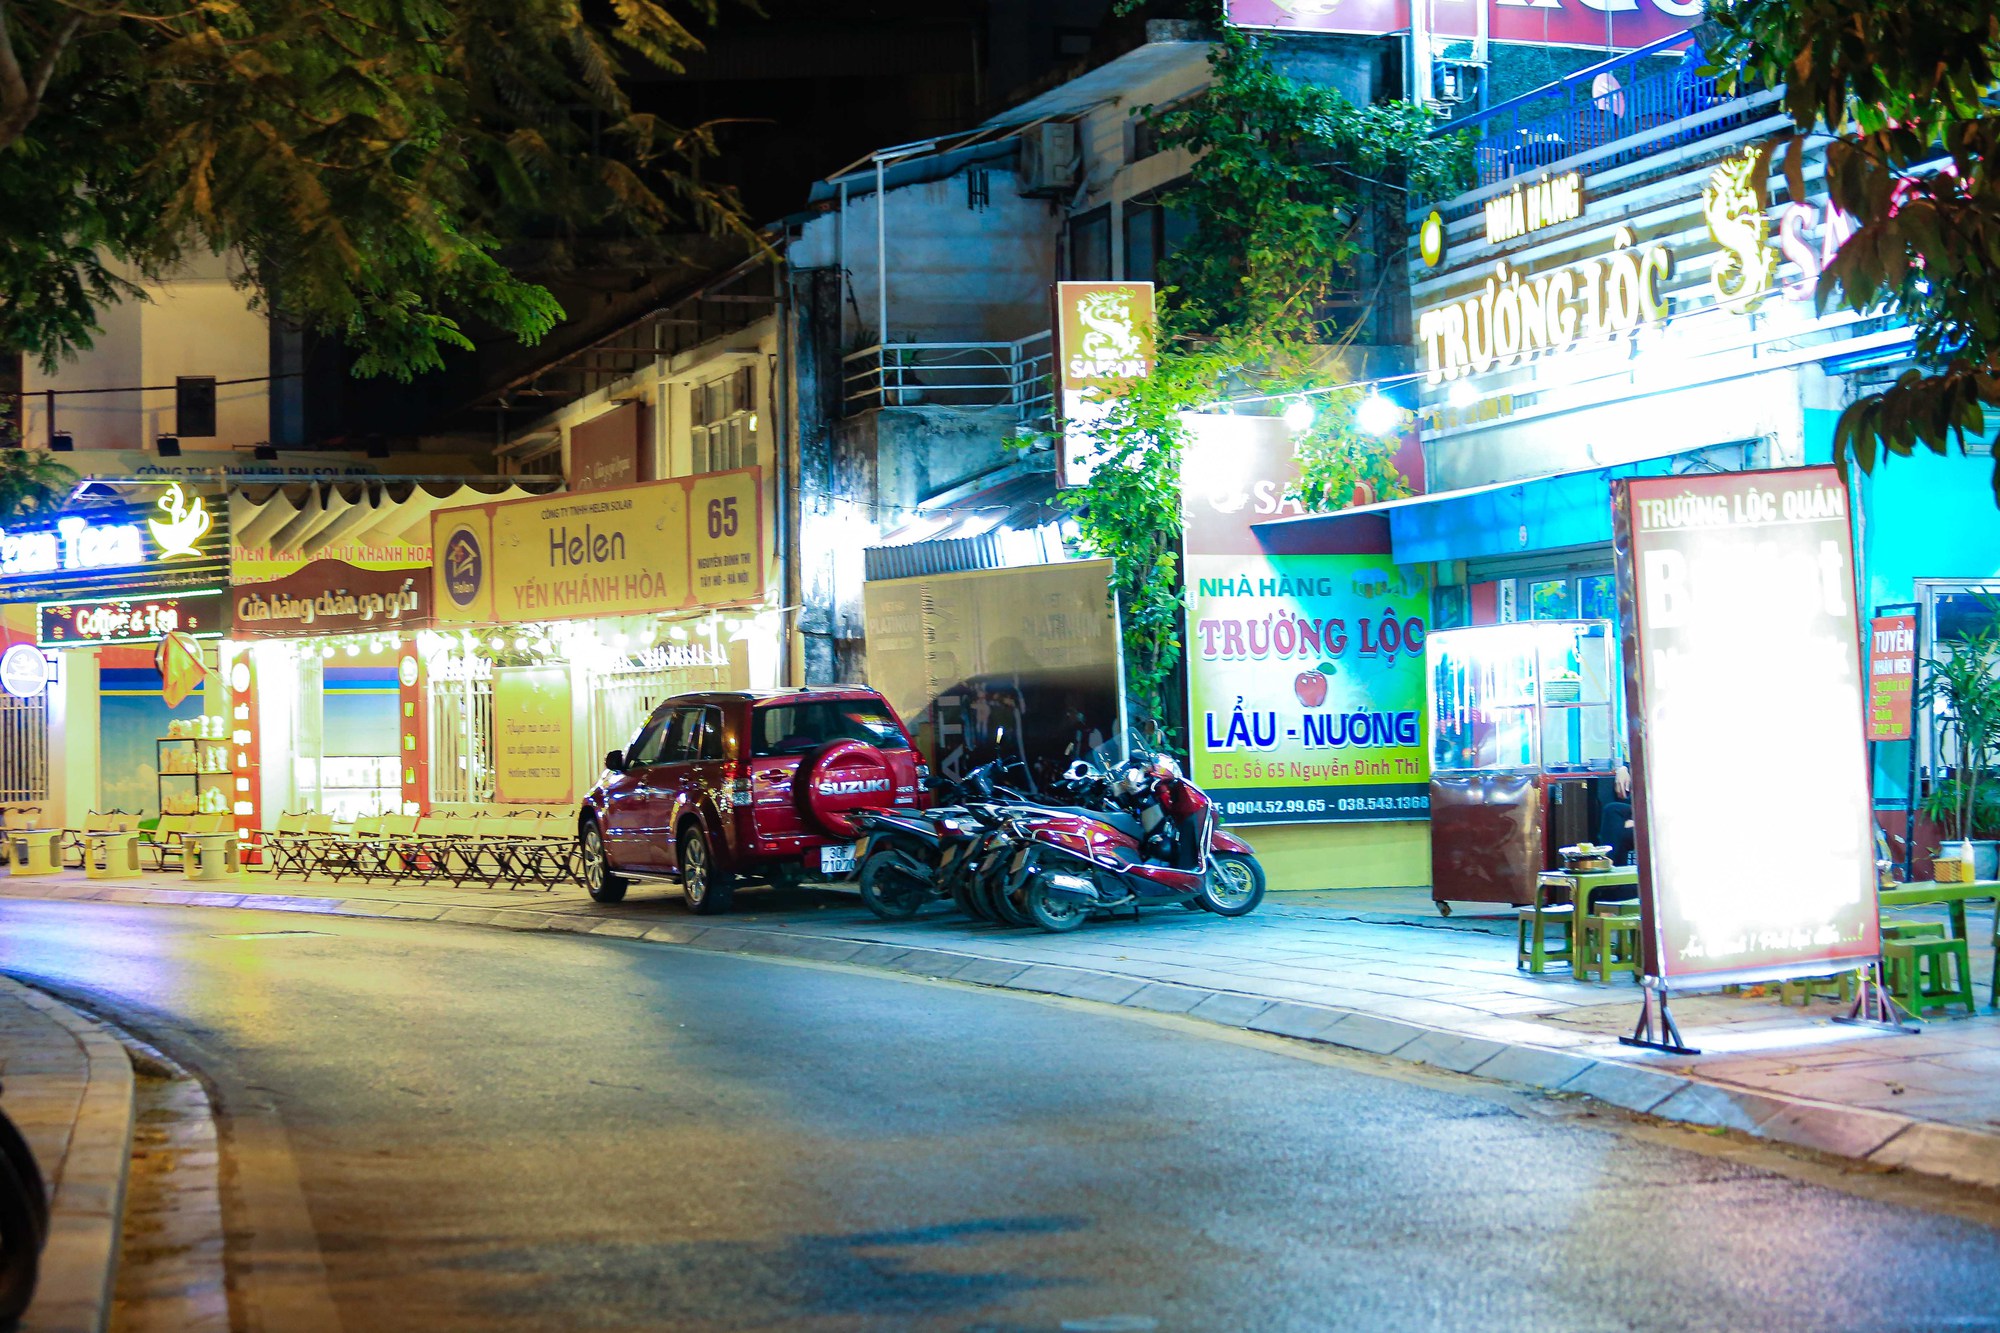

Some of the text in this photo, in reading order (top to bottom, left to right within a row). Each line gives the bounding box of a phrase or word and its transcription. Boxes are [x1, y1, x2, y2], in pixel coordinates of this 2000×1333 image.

[1485, 173, 1579, 244] NHÀ HÀNG
[1420, 262, 1578, 384] TRƯỜNG
[707, 496, 738, 539] 65
[1638, 490, 1729, 530] TRƯỜNG
[1783, 483, 1844, 520] QUÁN
[550, 524, 625, 567] Helen
[514, 568, 668, 609] YẾN KHÁNH HÒA
[1199, 573, 1332, 597] NHÀ HÀNG
[238, 592, 270, 621] Cửa
[271, 592, 314, 624] hàng
[315, 589, 358, 615] chăn
[358, 593, 384, 620] ga
[1199, 607, 1424, 663] TRƯỜNG LỘC
[1874, 621, 1914, 653] TUYỂN
[1207, 696, 1276, 748] LẨU
[1303, 706, 1419, 746] NƯỚNG
[819, 779, 890, 795] SUZUKI
[1213, 757, 1420, 782] ĐC: Số 65 Nguyễn Đình Thi
[1227, 798, 1325, 815] 0904.52.99.65
